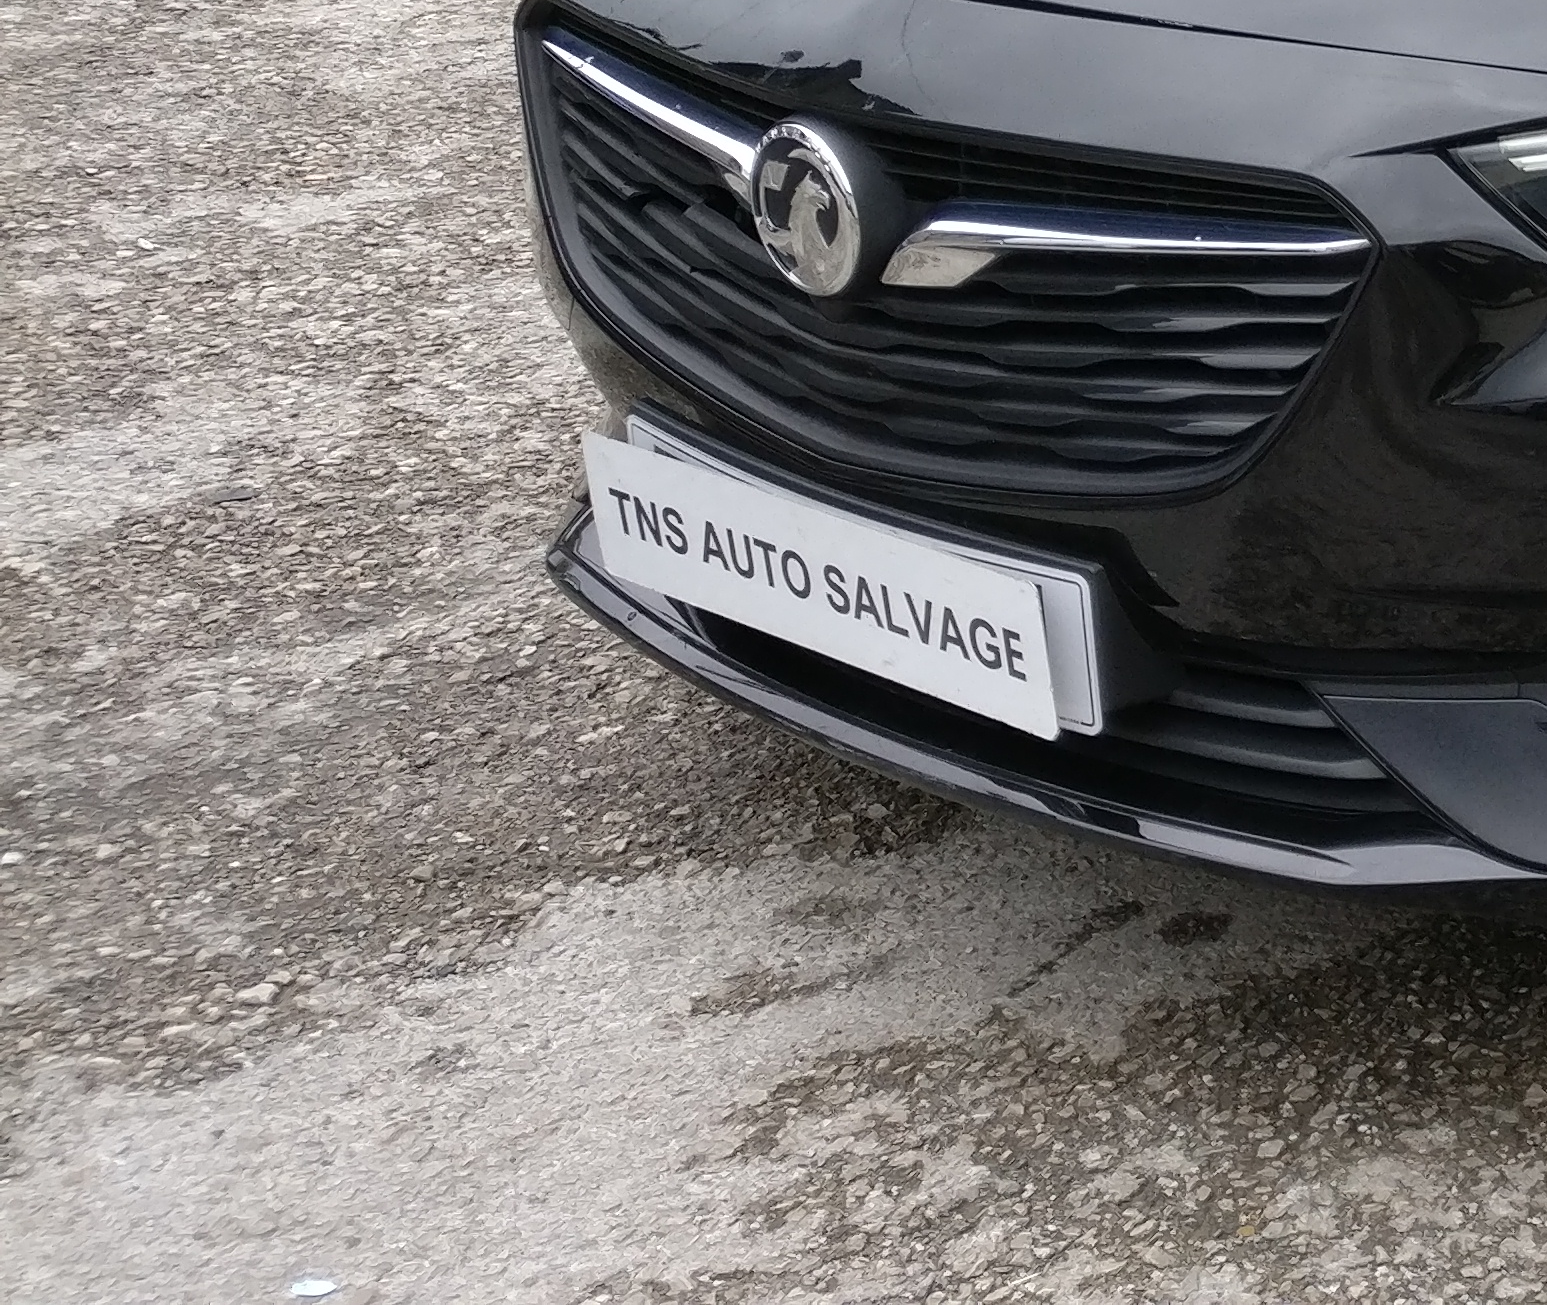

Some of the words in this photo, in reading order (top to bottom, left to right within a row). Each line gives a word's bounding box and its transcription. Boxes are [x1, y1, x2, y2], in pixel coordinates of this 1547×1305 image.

[608, 487, 690, 555] TNS
[701, 520, 812, 600] AUTO
[823, 564, 1028, 682] SALVAGE
